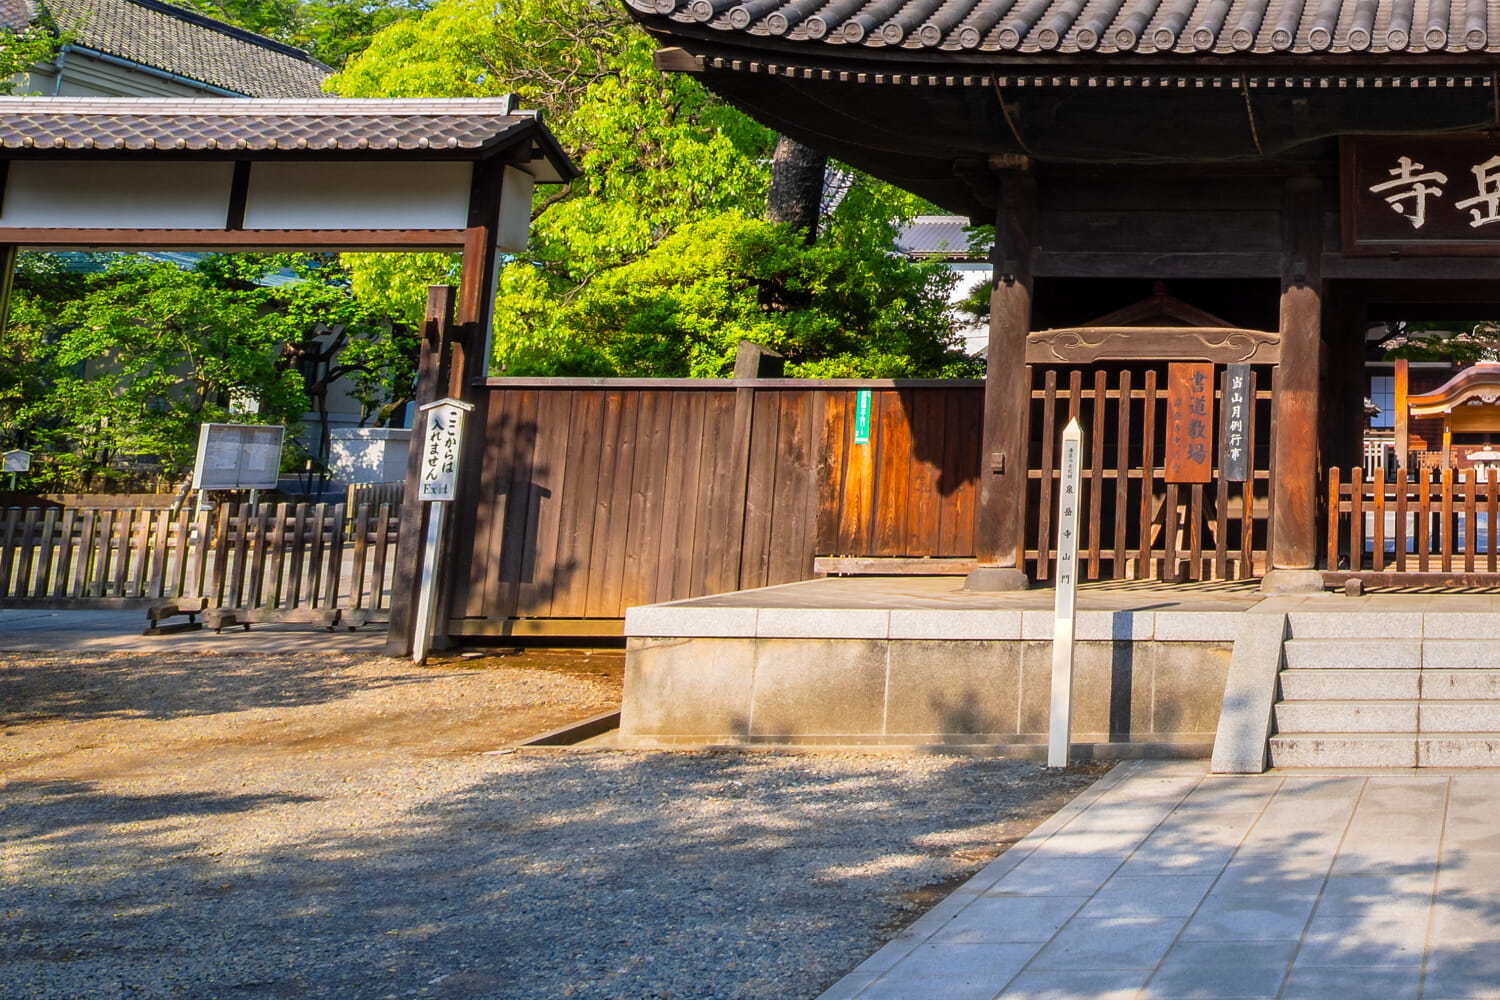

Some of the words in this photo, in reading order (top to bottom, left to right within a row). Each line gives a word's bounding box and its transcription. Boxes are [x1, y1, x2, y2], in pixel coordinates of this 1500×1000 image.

[442, 412, 457, 473] ここからは
[1228, 376, 1243, 461] 当山月例行事
[425, 419, 445, 481] 入れません
[423, 483, 449, 495] Exit
[1061, 485, 1074, 585] 泉岳寺山門
